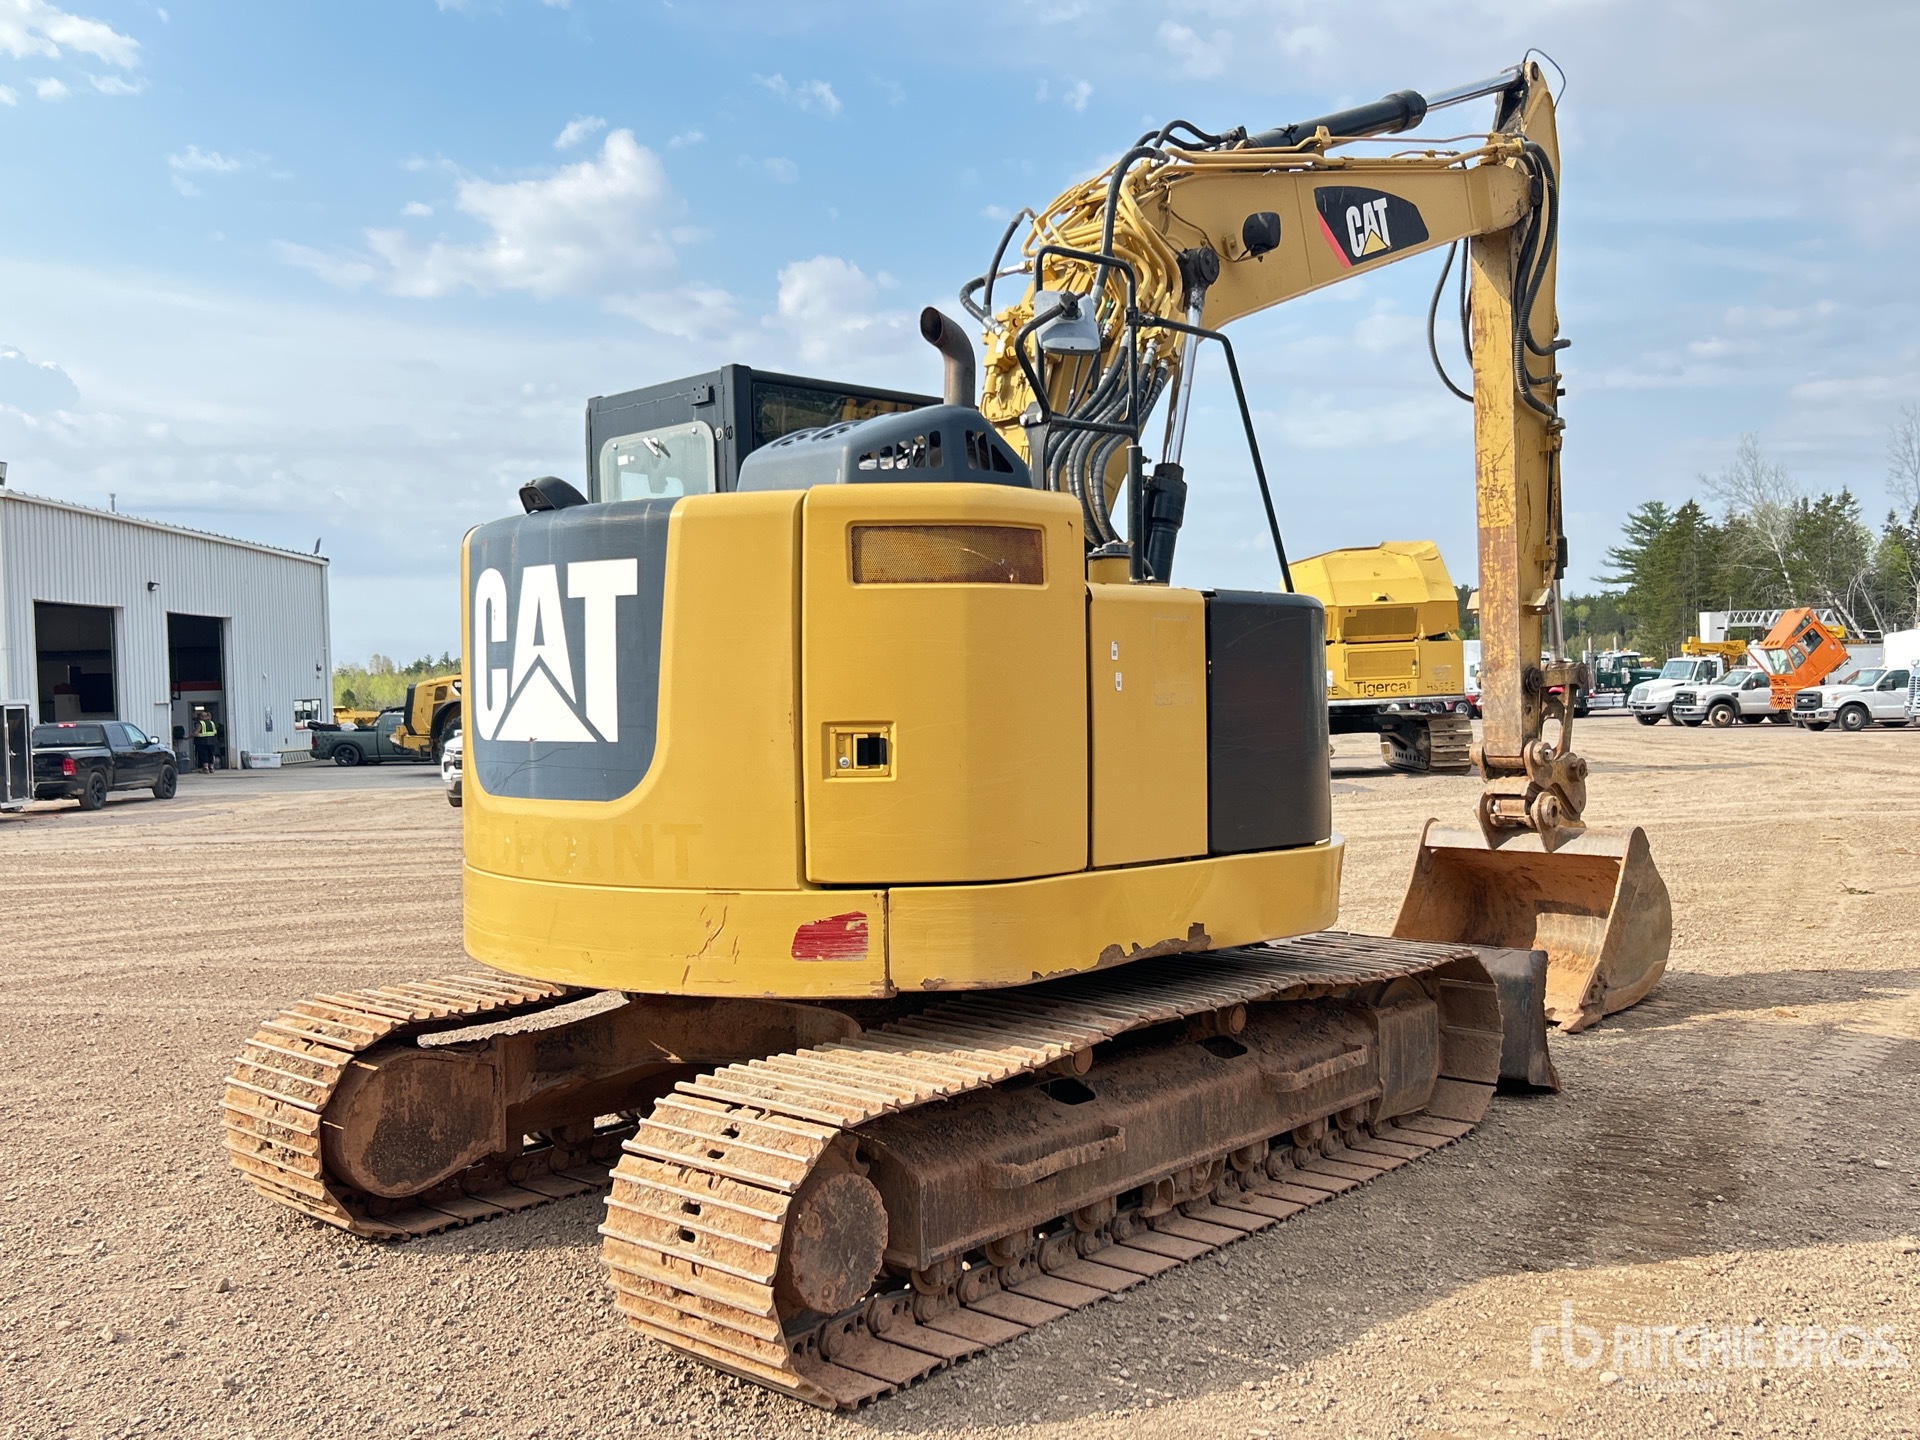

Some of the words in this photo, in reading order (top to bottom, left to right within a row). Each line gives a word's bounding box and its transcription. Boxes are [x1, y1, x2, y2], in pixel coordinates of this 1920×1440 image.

[1346, 197, 1392, 258] CAT
[474, 558, 638, 743] CAT
[1353, 681, 1412, 697] Tigercat
